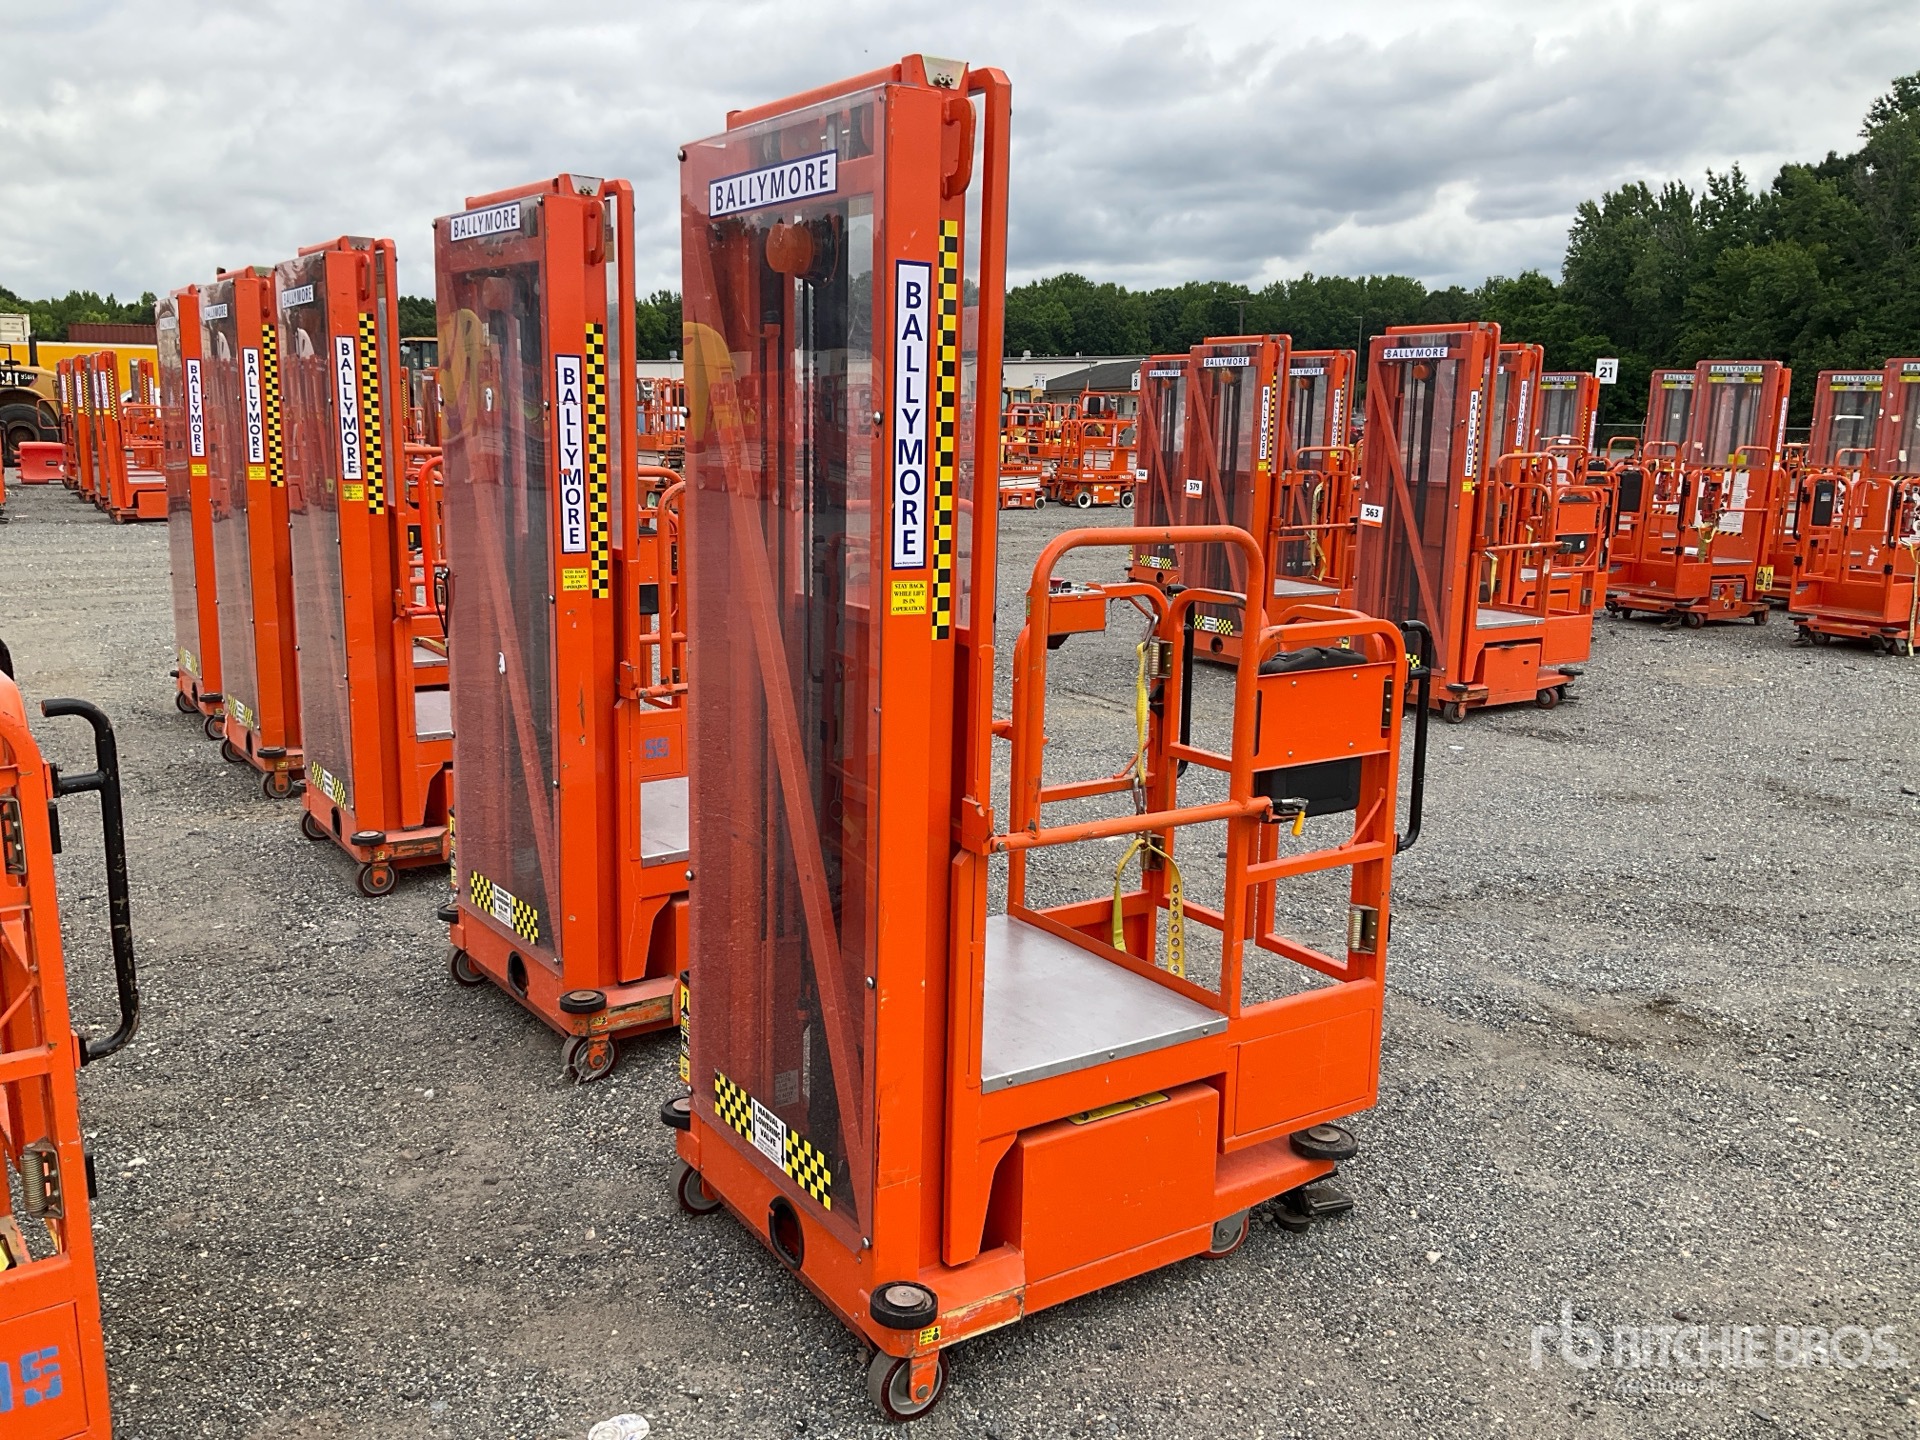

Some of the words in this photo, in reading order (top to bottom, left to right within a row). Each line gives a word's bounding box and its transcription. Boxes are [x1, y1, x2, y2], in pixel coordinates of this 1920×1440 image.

[715, 159, 831, 212] BALLYMORE
[453, 207, 517, 238] BALLYMORE
[283, 286, 312, 306] BALLYMORE
[1206, 357, 1247, 366] BALLYMORE
[1388, 348, 1445, 358] BALLYMORE
[1134, 378, 1138, 387] 8
[1599, 367, 1612, 378] 21
[190, 365, 202, 453] BALLYMORE
[247, 353, 261, 458] BALLYMORE
[341, 343, 357, 473] BALLYMORE
[898, 281, 924, 555] BALLYMORE
[1467, 394, 1476, 473] BALLYMORE
[563, 367, 582, 545] BALLYMORE
[1190, 482, 1200, 491] 579
[1366, 507, 1379, 518] 563
[755, 1114, 781, 1141] LOWERING
[757, 1105, 779, 1129] MANUAL
[760, 1127, 776, 1147] VALVE
